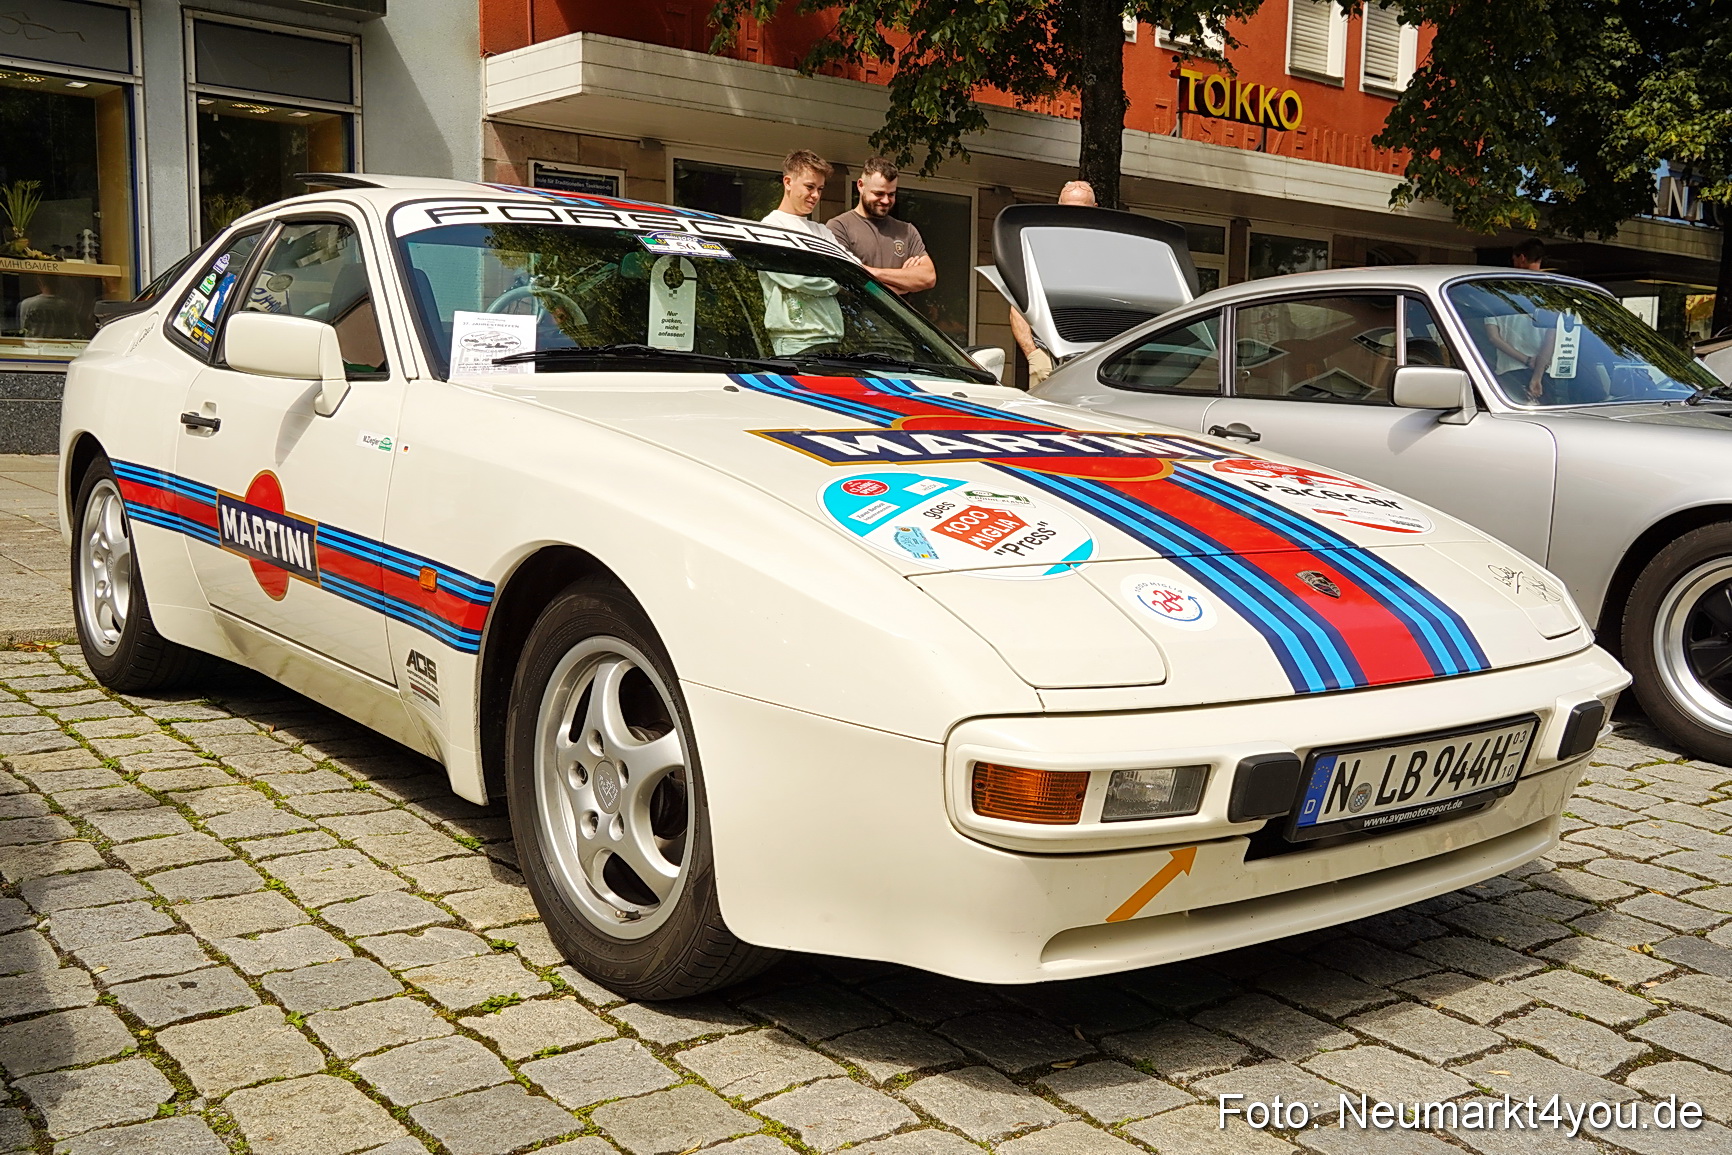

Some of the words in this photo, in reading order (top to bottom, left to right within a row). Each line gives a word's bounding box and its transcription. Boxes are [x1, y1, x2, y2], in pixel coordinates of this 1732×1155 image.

[424, 205, 848, 260] PORSCHE
[801, 433, 1226, 457] MARTINI
[1245, 479, 1404, 511] Pacecar
[923, 501, 956, 520] goes
[943, 510, 990, 535] 1000
[222, 504, 312, 572] MARTINI
[968, 518, 1021, 548] MIGLIA
[994, 521, 1057, 556] "Press"
[1512, 730, 1527, 745] 03
[1324, 759, 1361, 815] N
[1375, 751, 1428, 807] LB
[1425, 733, 1514, 798] 944H
[1501, 763, 1515, 779] 10
[1303, 799, 1317, 815] D
[1363, 799, 1463, 828] www.avpmotorsport.de
